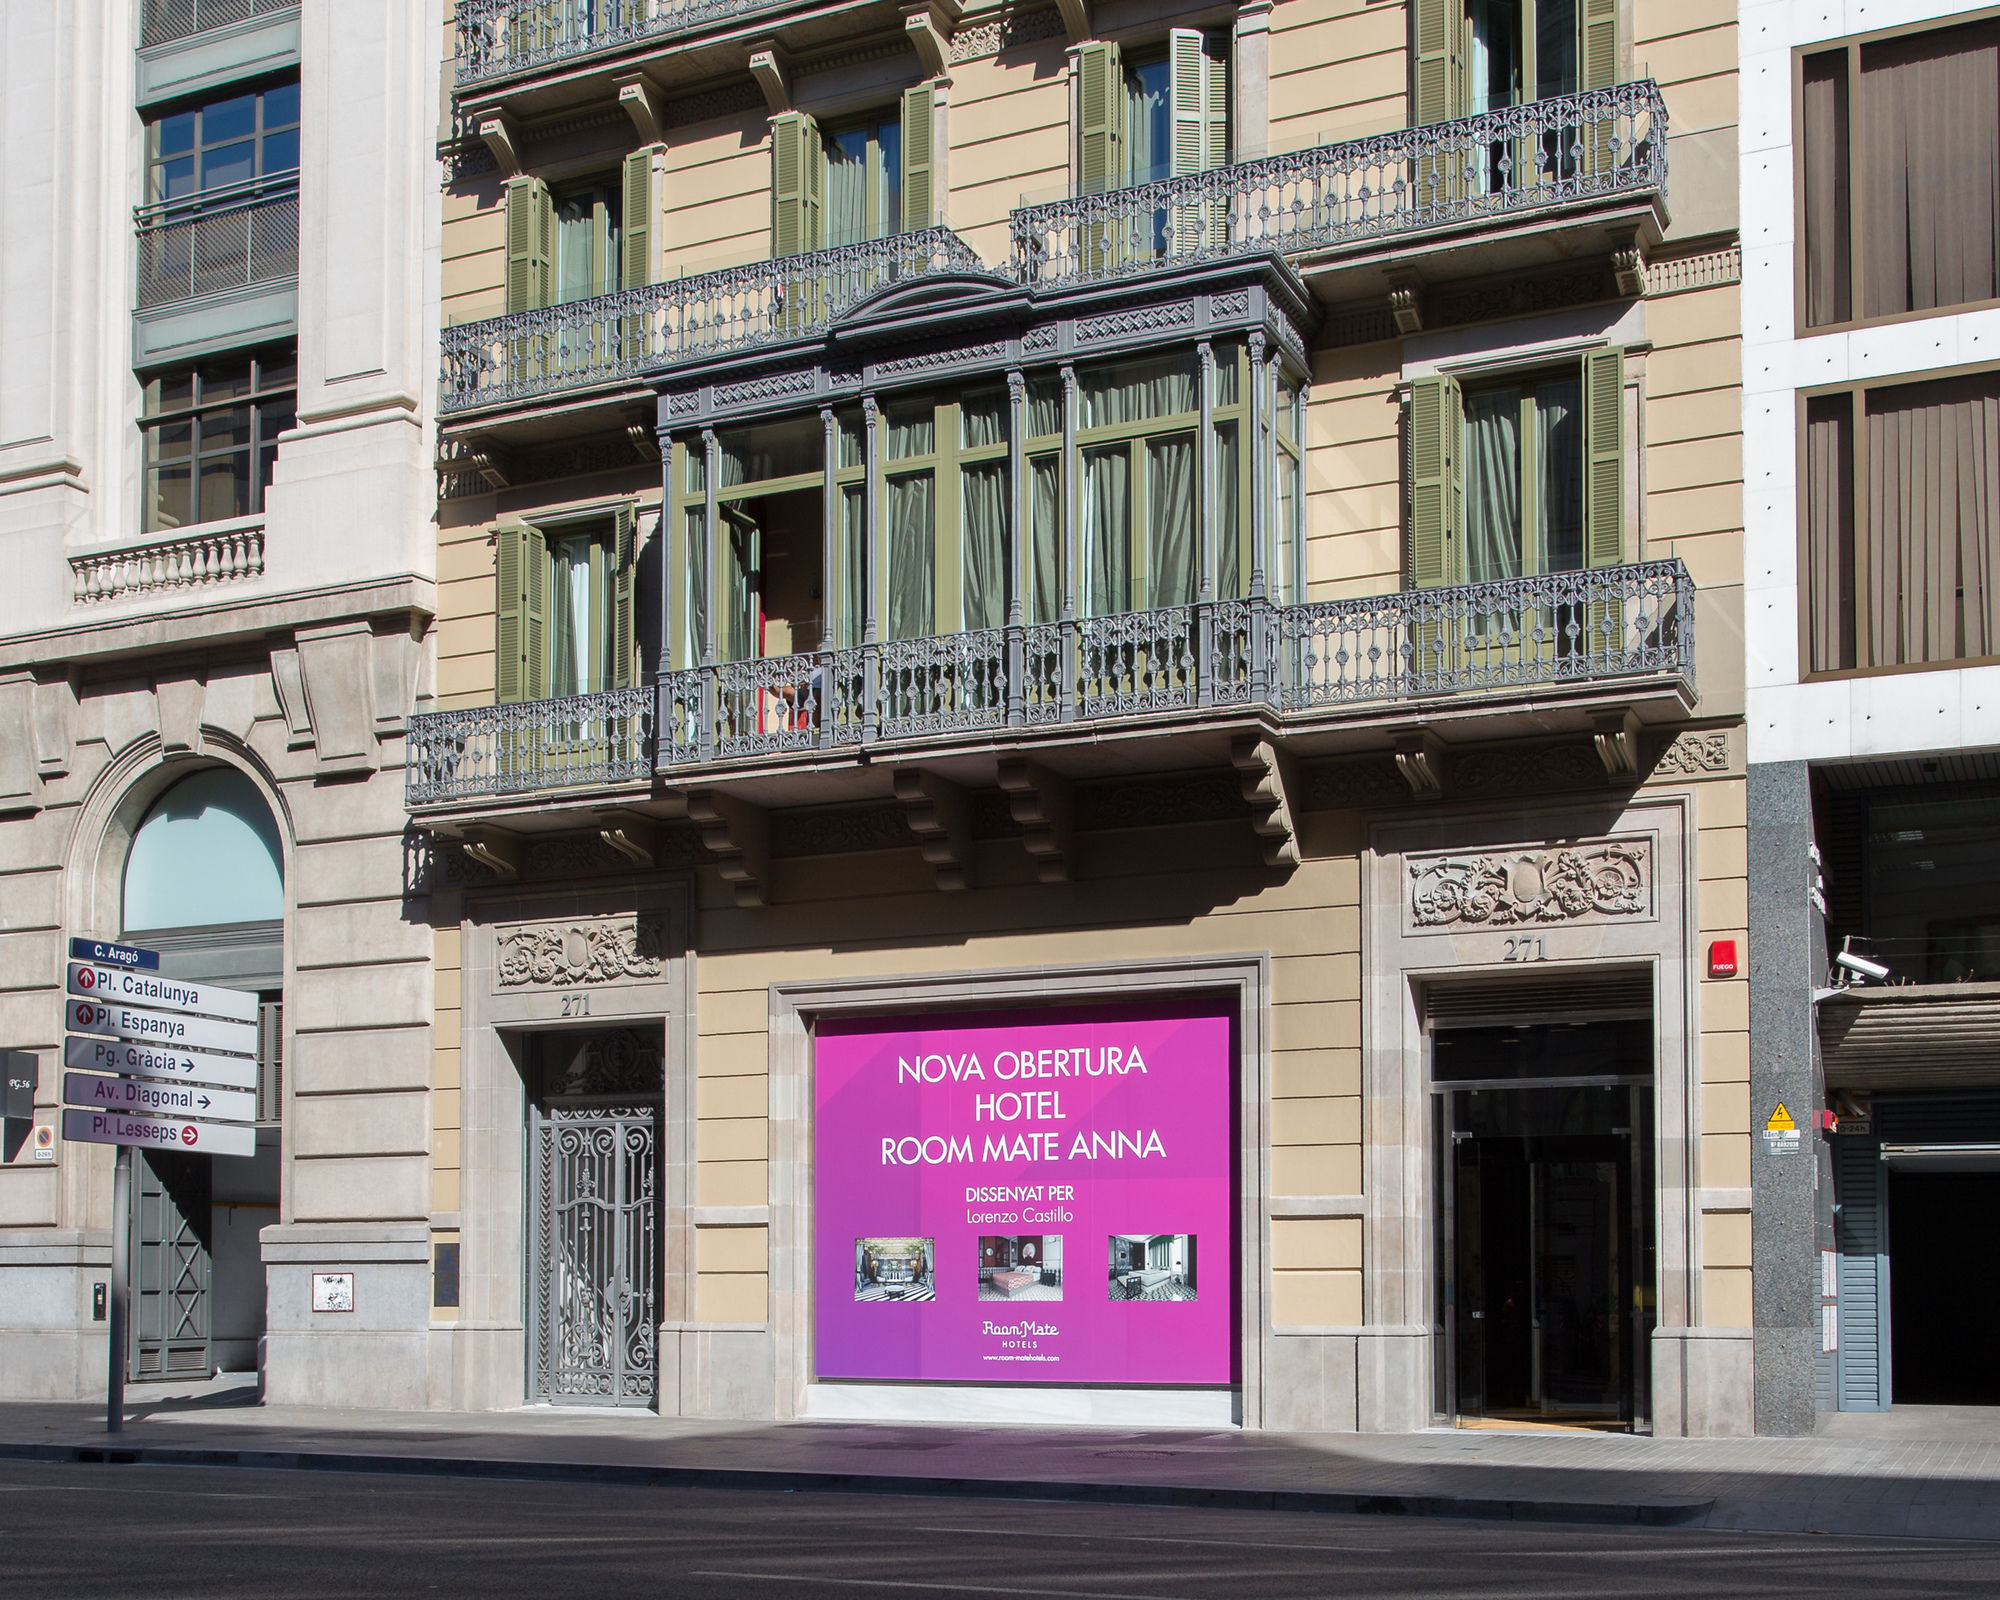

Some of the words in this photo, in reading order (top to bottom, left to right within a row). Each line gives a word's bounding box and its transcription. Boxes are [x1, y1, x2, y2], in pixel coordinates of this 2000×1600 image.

[94, 944, 106, 957] C.
[108, 947, 139, 964] Aragó
[1503, 935, 1547, 961] 271
[97, 971, 117, 991] Pl.
[123, 976, 199, 1005] Catalunya
[560, 993, 591, 1016] 271
[96, 1008, 115, 1027] Pl.
[121, 1011, 185, 1038] Espanya
[95, 1044, 120, 1067] Pg.
[126, 1048, 176, 1070] Gràcia
[898, 1052, 986, 1084] NOVA
[993, 1045, 1148, 1080] OBERTURA
[95, 1080, 119, 1100] Av.
[126, 1084, 193, 1108] Diagonal
[975, 1091, 1066, 1121] HOTEL
[93, 1116, 111, 1134] Pl.
[116, 1118, 178, 1143] Lesseps
[881, 1135, 974, 1165] ROOM
[982, 1132, 1059, 1162] MATE
[1068, 1128, 1167, 1160] ANNA
[965, 1186, 1044, 1202] DISSENYAT
[1048, 1185, 1075, 1201] PER
[967, 1208, 1019, 1224] Lorenzo
[1022, 1206, 1074, 1223] Castillo
[982, 1353, 1060, 1362] www.room-matehotels.com
[1002, 1340, 1038, 1349] HOTELS
